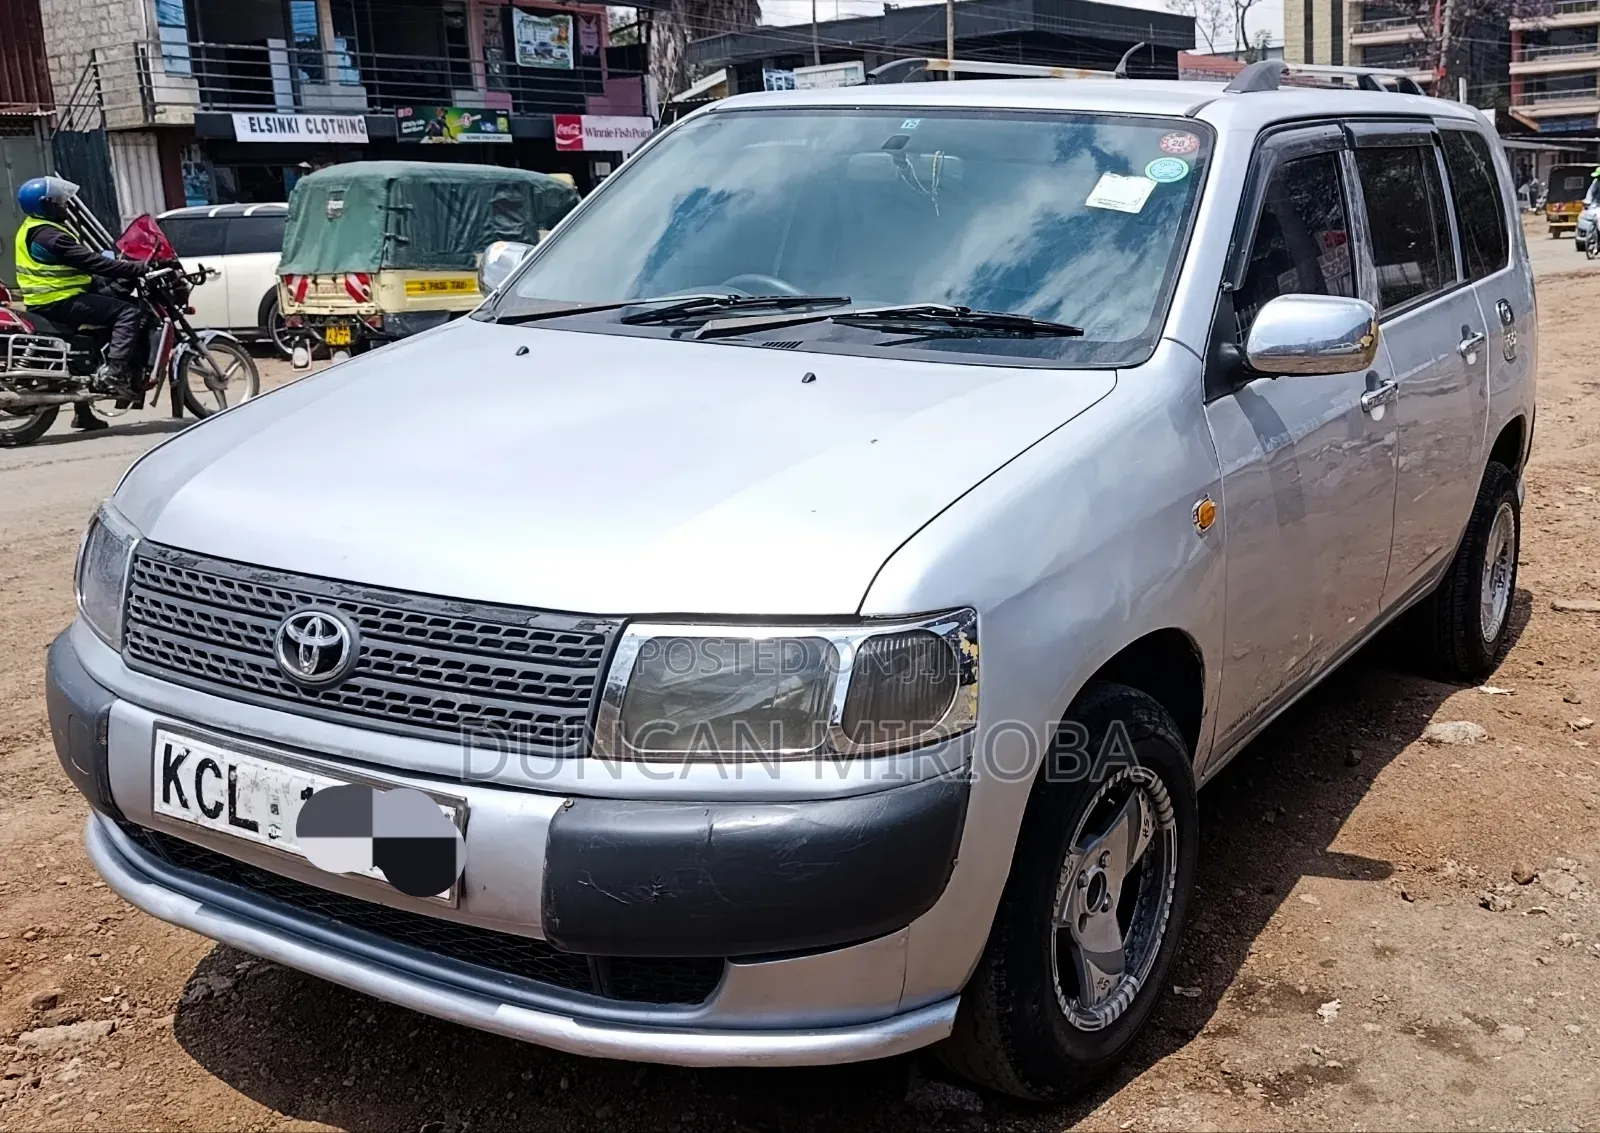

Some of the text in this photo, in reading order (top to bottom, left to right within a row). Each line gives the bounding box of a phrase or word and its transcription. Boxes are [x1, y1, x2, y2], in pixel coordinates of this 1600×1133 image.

[305, 117, 366, 135] CLOTHING
[584, 127, 614, 139] Winnie
[614, 127, 632, 139] Fish
[1171, 139, 1186, 148] 28
[429, 281, 448, 291] PASS
[161, 742, 260, 834] KCL
